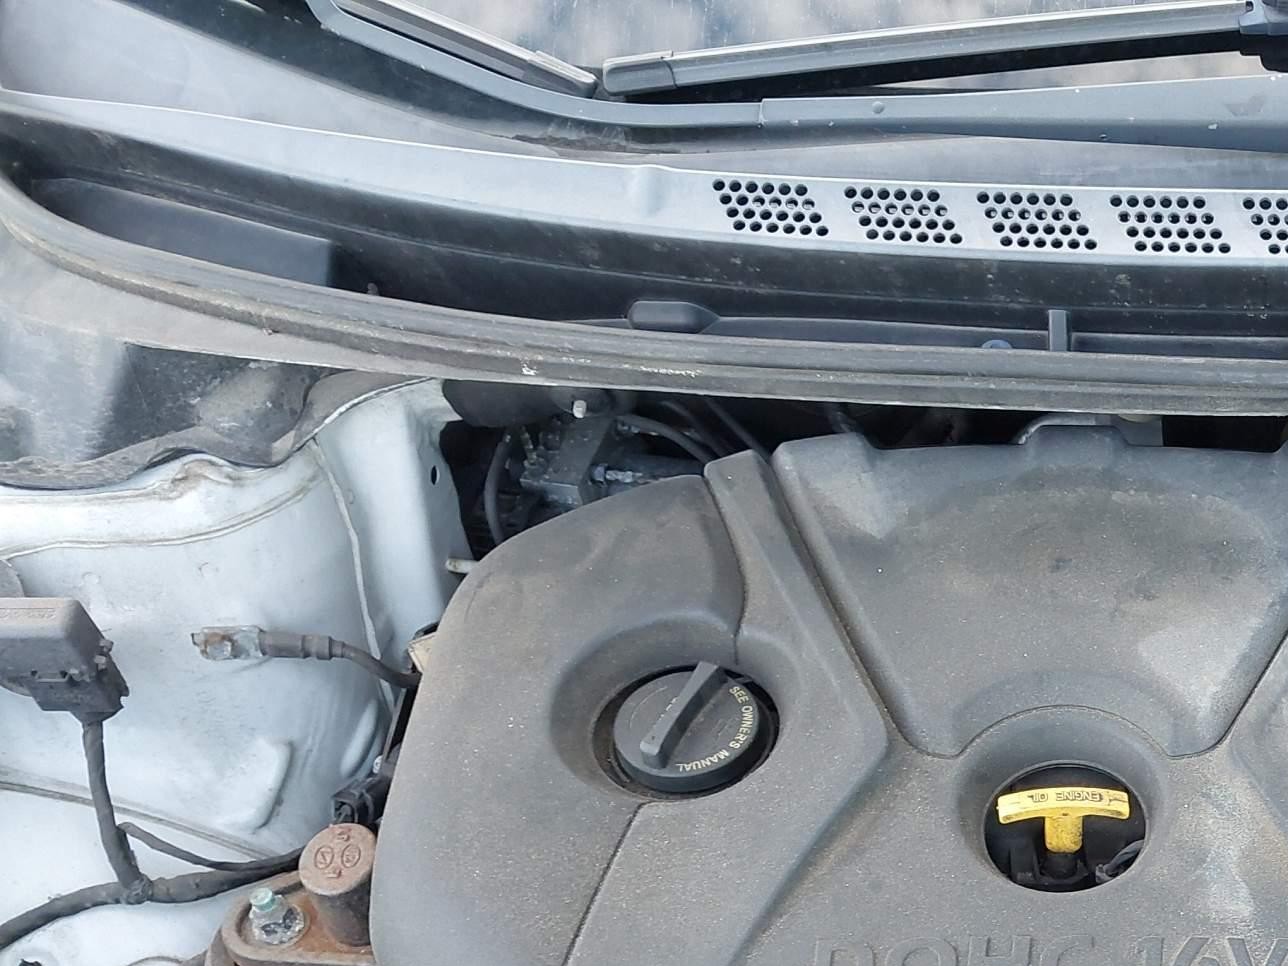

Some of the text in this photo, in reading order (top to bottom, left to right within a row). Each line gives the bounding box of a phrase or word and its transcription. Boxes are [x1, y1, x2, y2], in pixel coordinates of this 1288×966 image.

[676, 686, 753, 772] SEE OWNER'S MANUAL
[1027, 790, 1103, 803] ENGINE OIL
